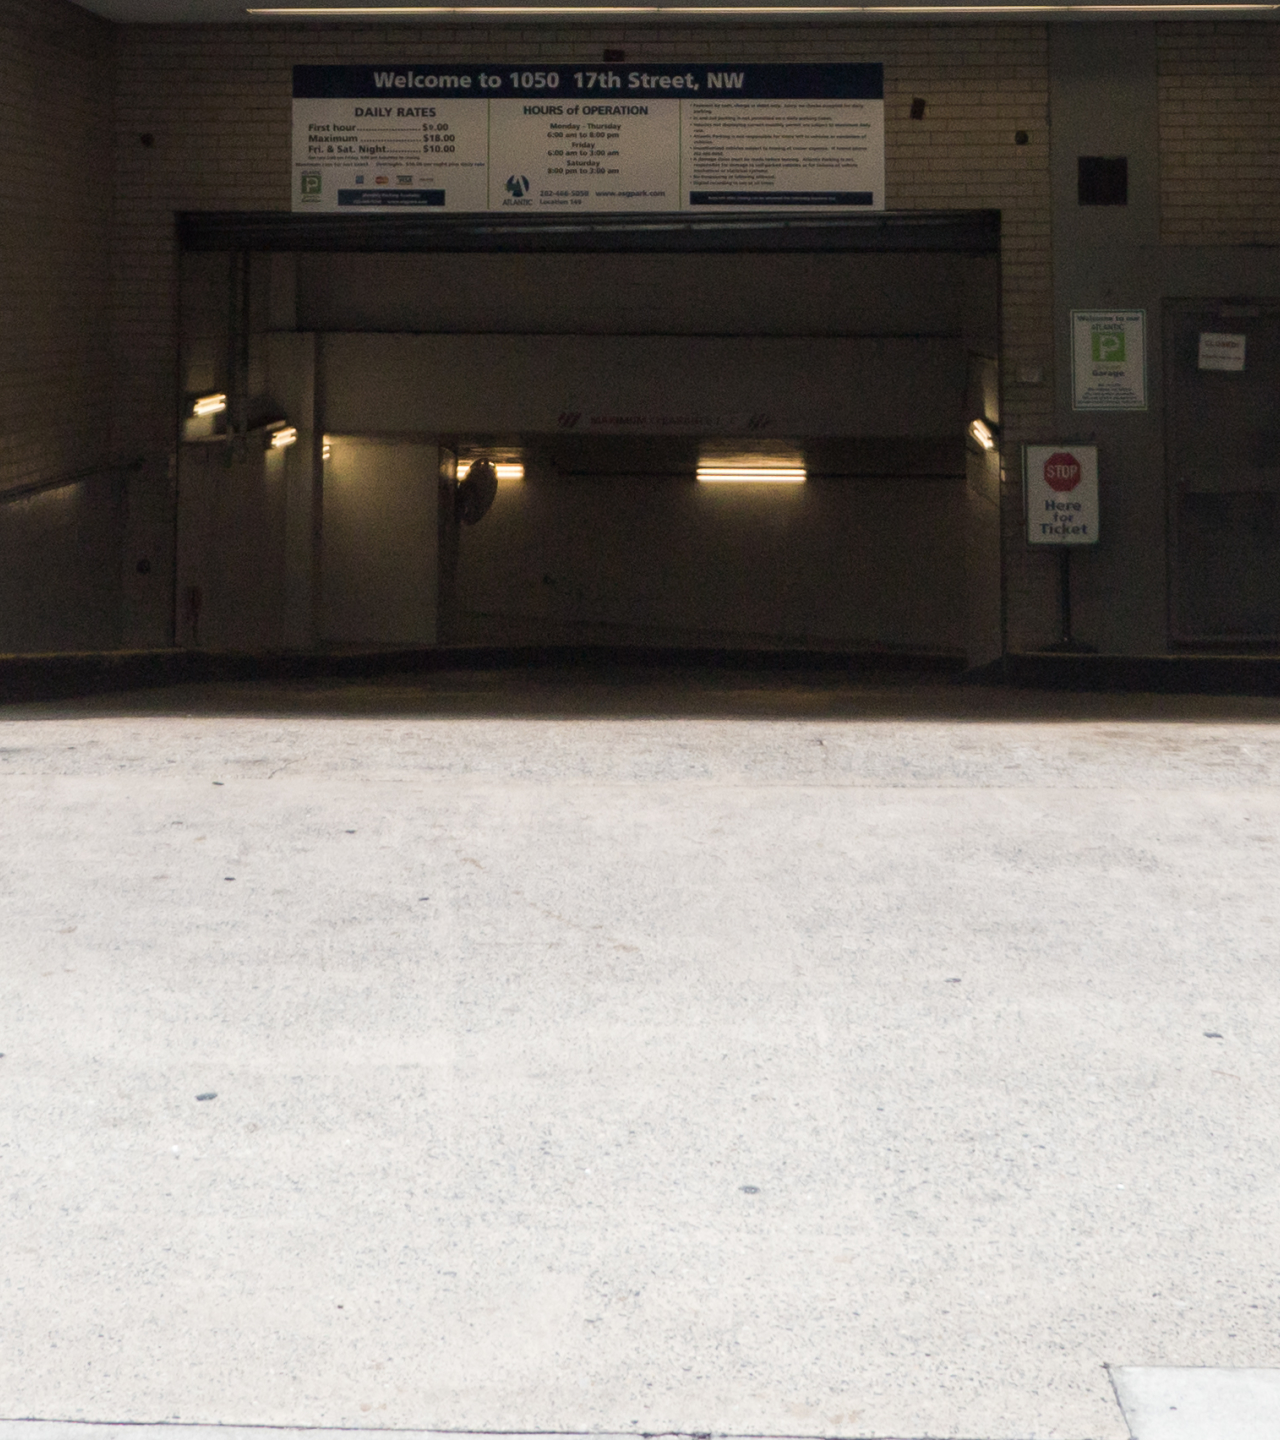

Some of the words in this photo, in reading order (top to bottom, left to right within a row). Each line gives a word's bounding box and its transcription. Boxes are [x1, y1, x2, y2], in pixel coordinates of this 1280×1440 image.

[373, 71, 472, 88] Welcome
[479, 72, 502, 89] to
[510, 72, 559, 88] 1050
[573, 71, 621, 88] 17th
[628, 71, 699, 91] Street,
[707, 72, 744, 88] NW
[354, 107, 393, 117] DAILY
[397, 107, 436, 117] RATES
[523, 106, 563, 115] HOURS
[566, 106, 579, 115] of
[582, 106, 648, 115] OPERATION
[308, 124, 331, 132] First
[550, 123, 580, 131] Monday
[587, 123, 621, 131] Thursday
[308, 134, 358, 142] Maximum
[308, 145, 324, 153] Fri.
[337, 145, 355, 153] Sat.
[359, 145, 386, 155] Night
[423, 145, 455, 153] $10.00
[571, 142, 595, 150] Friday
[1092, 370, 1124, 378] Garage
[1047, 465, 1078, 478] STOP
[1045, 500, 1081, 511] Here
[1053, 513, 1073, 522] for
[1040, 523, 1088, 534] Ticket
